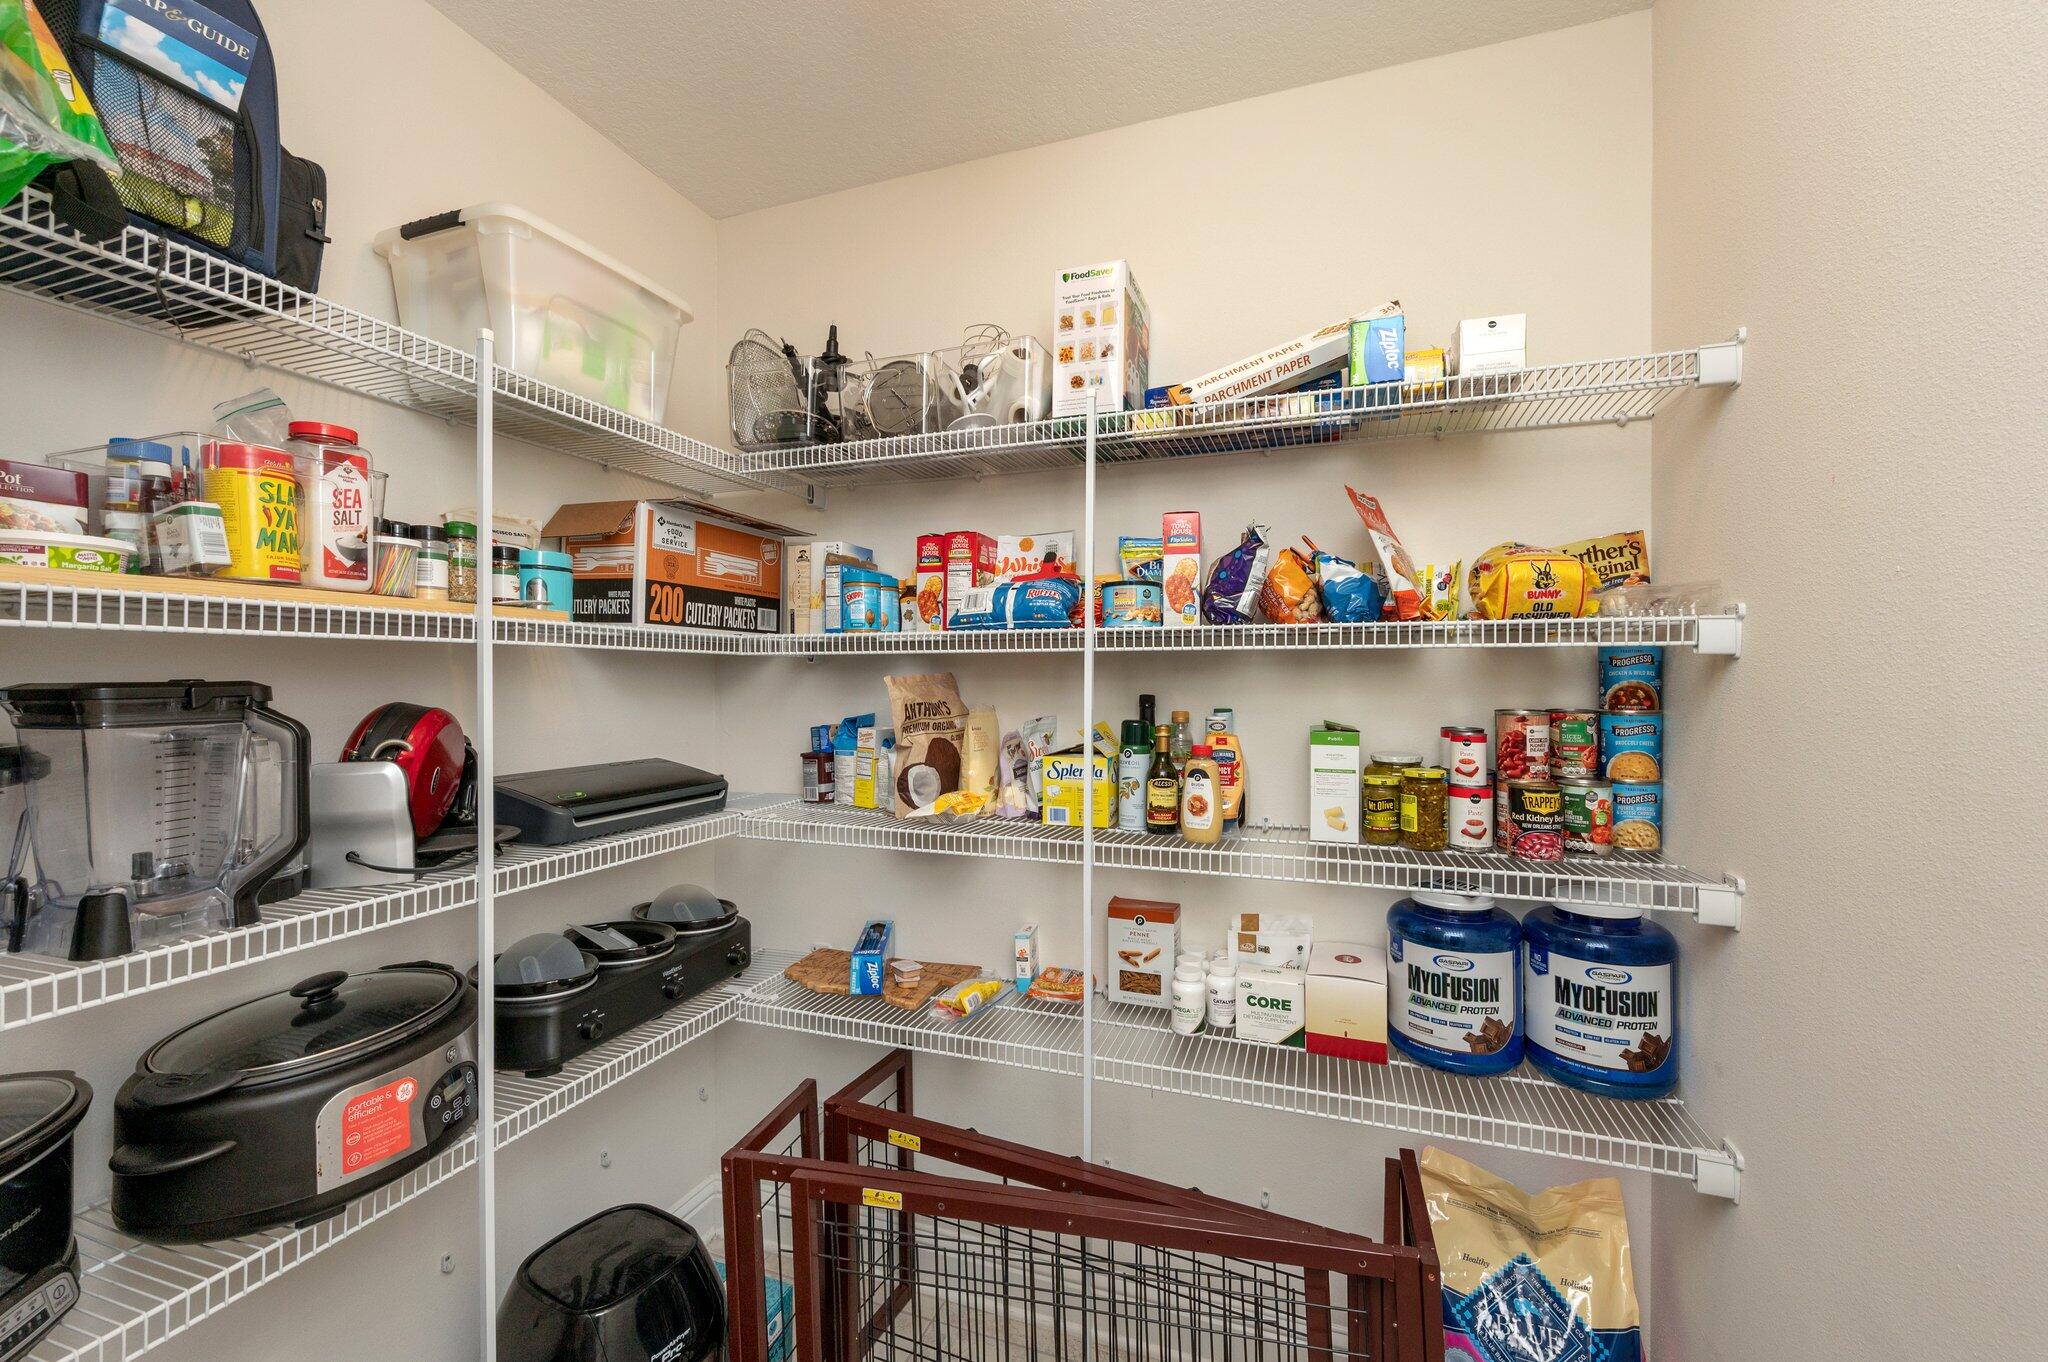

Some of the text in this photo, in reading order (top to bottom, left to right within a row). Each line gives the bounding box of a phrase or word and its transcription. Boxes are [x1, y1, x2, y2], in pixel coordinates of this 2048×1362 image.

[165, 9, 188, 21] &
[186, 18, 250, 60] GUIDE
[1378, 328, 1399, 369] Ziploc
[1196, 342, 1304, 389] PARCHMENT PAPER
[1204, 354, 1312, 403] PARCHMENT PAPER
[259, 481, 302, 507] SLA
[332, 488, 362, 509] SEA
[273, 506, 294, 531] YA
[333, 510, 361, 526] SALT
[667, 528, 683, 537] FOOD
[661, 537, 688, 548] SERVICE
[1563, 540, 1642, 562] rther's
[62, 562, 112, 573] Margarita Salt
[1136, 567, 1163, 576] DIAM
[1593, 555, 1640, 579] iginal
[1527, 590, 1561, 600] BUNNY
[573, 599, 630, 614] UTLERY PACKETS
[649, 583, 756, 630] 200 CUTLERY PACKETS
[1532, 602, 1553, 612] OLD
[1612, 655, 1652, 667] PROGRESSO
[902, 720, 957, 734] PREMIUM ORGANI
[1615, 725, 1655, 736] PROGRESSO
[1219, 766, 1231, 775] ICY
[1377, 800, 1394, 810] Olive
[1617, 794, 1656, 805] PROGRESSO
[1512, 813, 1525, 821] Red
[1526, 813, 1554, 824] Kidney
[1438, 957, 1469, 966] GASPARI
[867, 961, 880, 989] Ziploc
[1591, 970, 1626, 980] GASPARI
[1246, 994, 1292, 1012] CORE
[1410, 994, 1500, 1015] ADVANCED PROTEIN
[1243, 1013, 1297, 1026] DIETARY SUPPLEMENT
[1558, 1008, 1658, 1030] ADVANCED PROTEIN
[348, 1090, 392, 1115] portable &
[348, 1104, 383, 1122] efficient
[12, 1207, 41, 1232] Beach
[1462, 1253, 1490, 1269] Healthy
